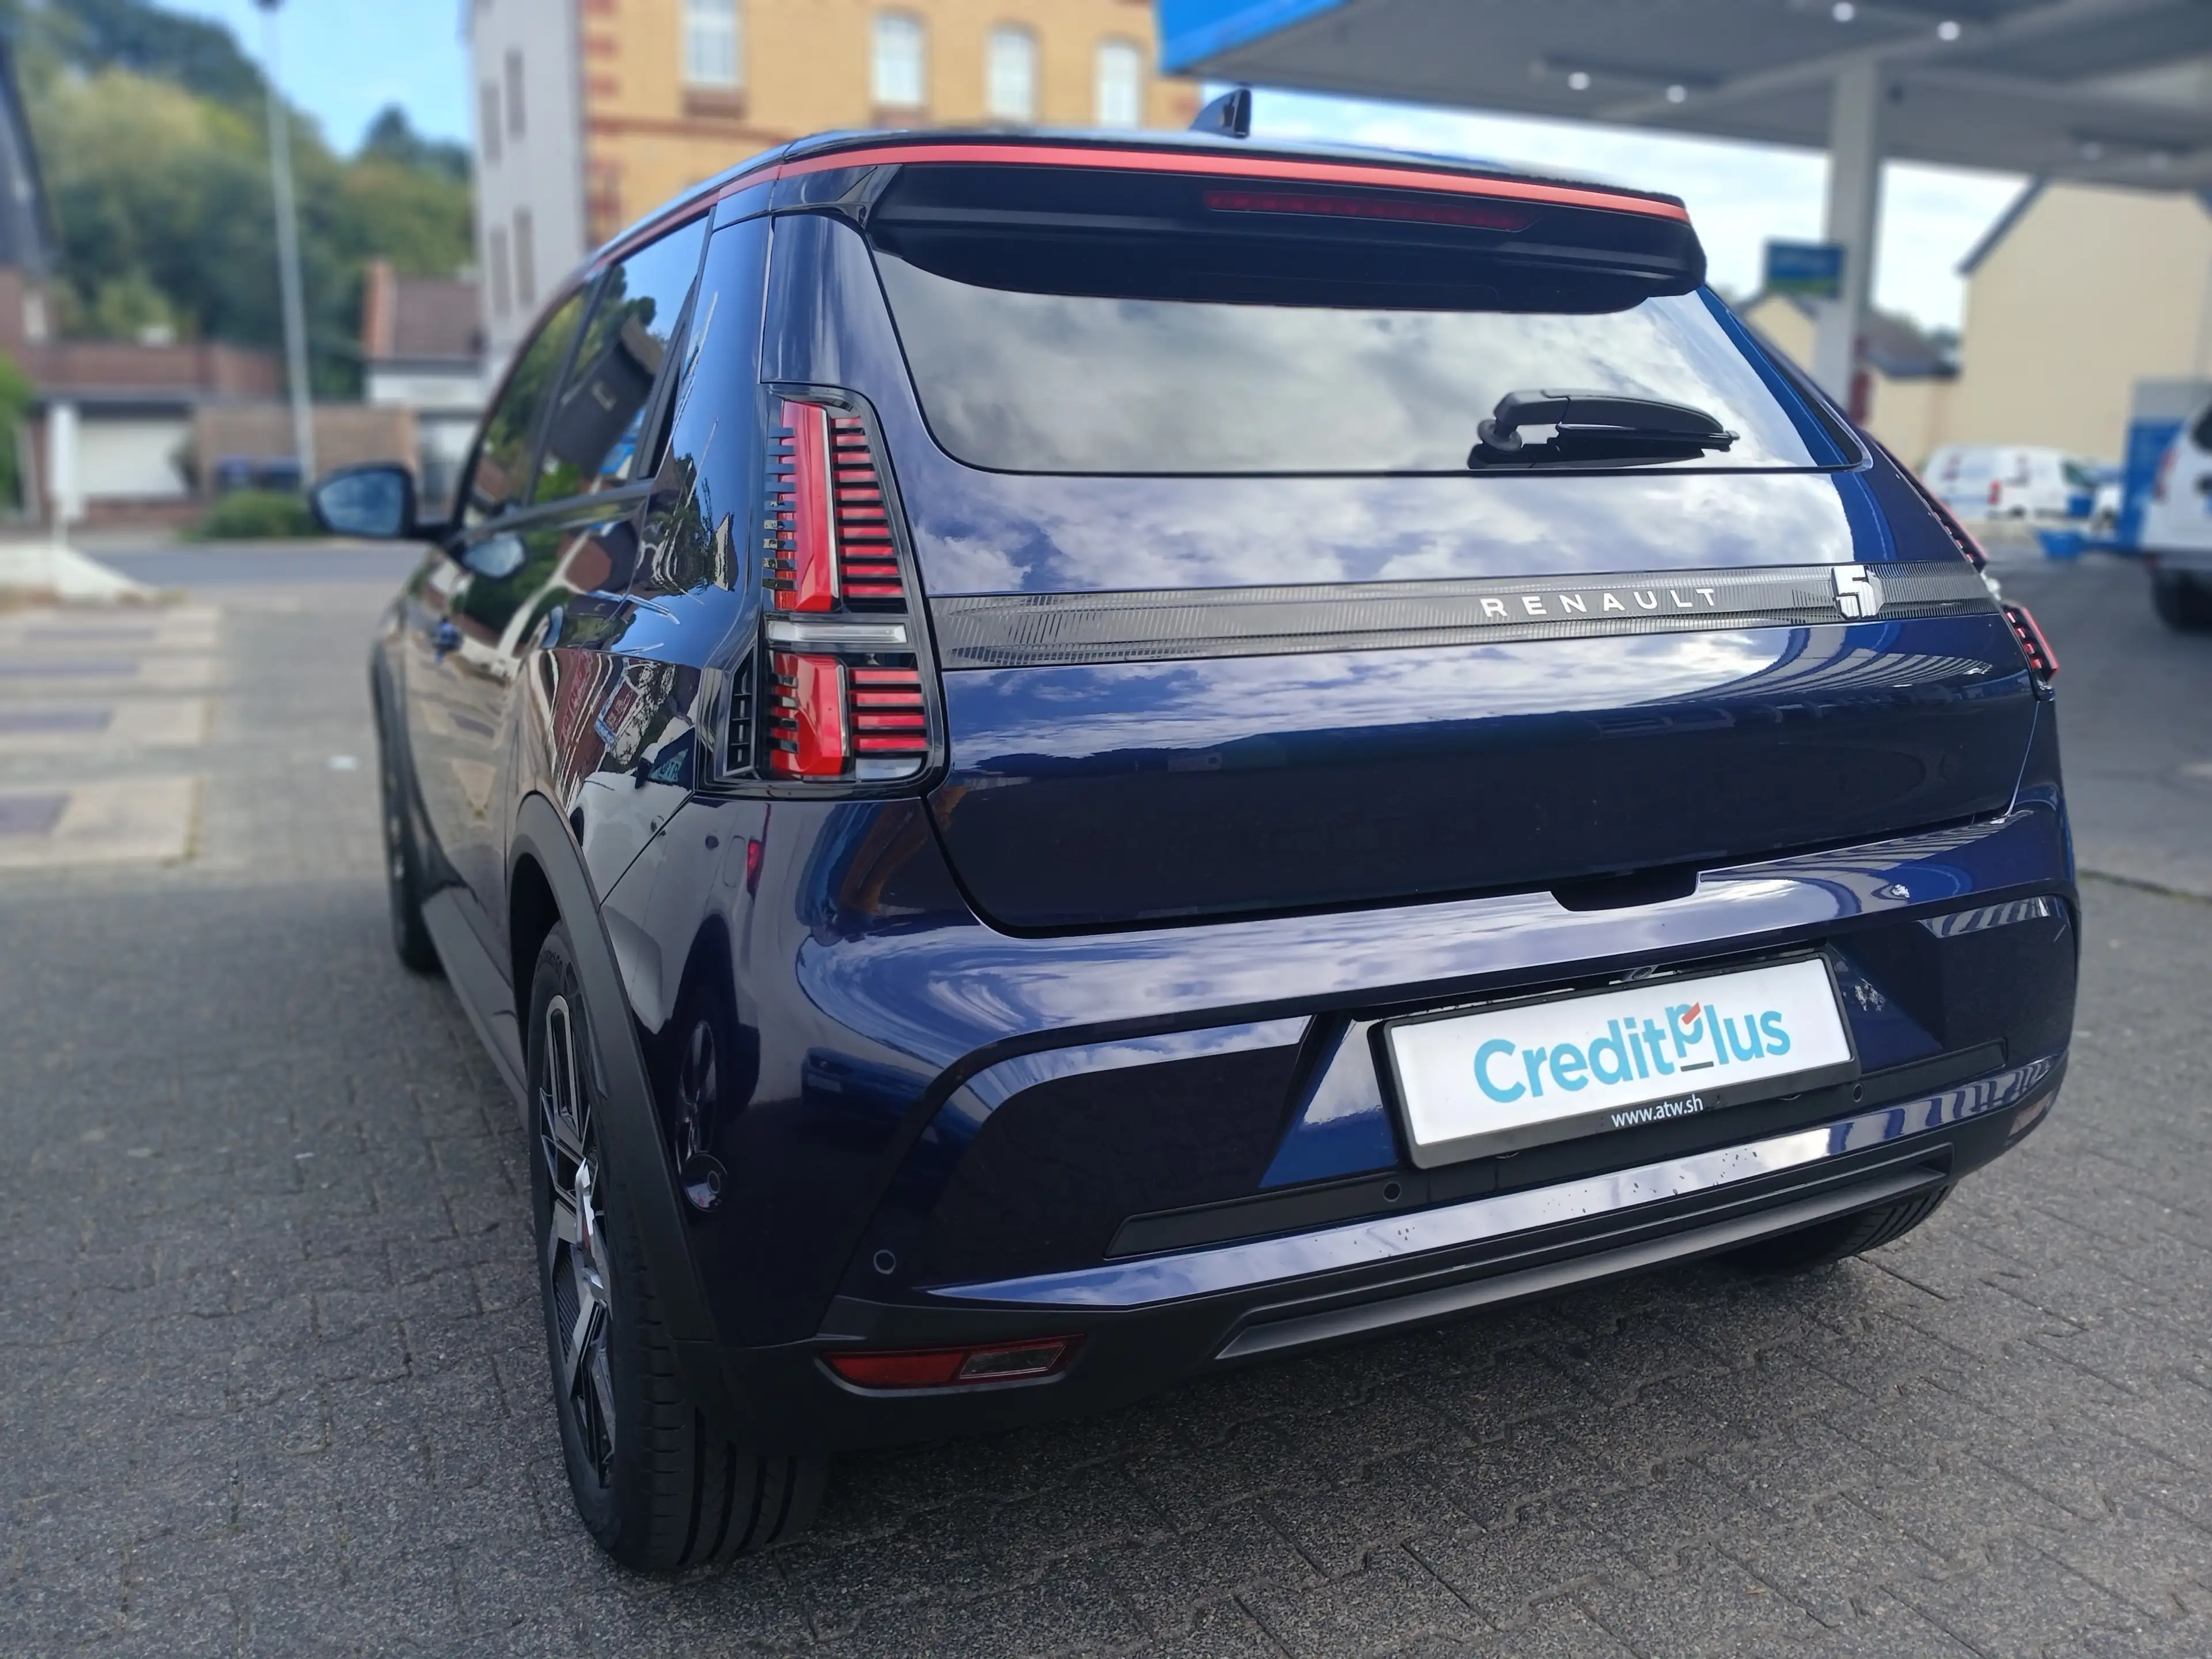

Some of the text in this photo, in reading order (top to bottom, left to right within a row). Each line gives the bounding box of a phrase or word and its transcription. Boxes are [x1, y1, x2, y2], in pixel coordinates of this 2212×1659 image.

[1480, 589, 1715, 618] RENAULT
[1474, 1002, 1791, 1103] CreditPlus
[1611, 1094, 1703, 1128] www.atw.sh
